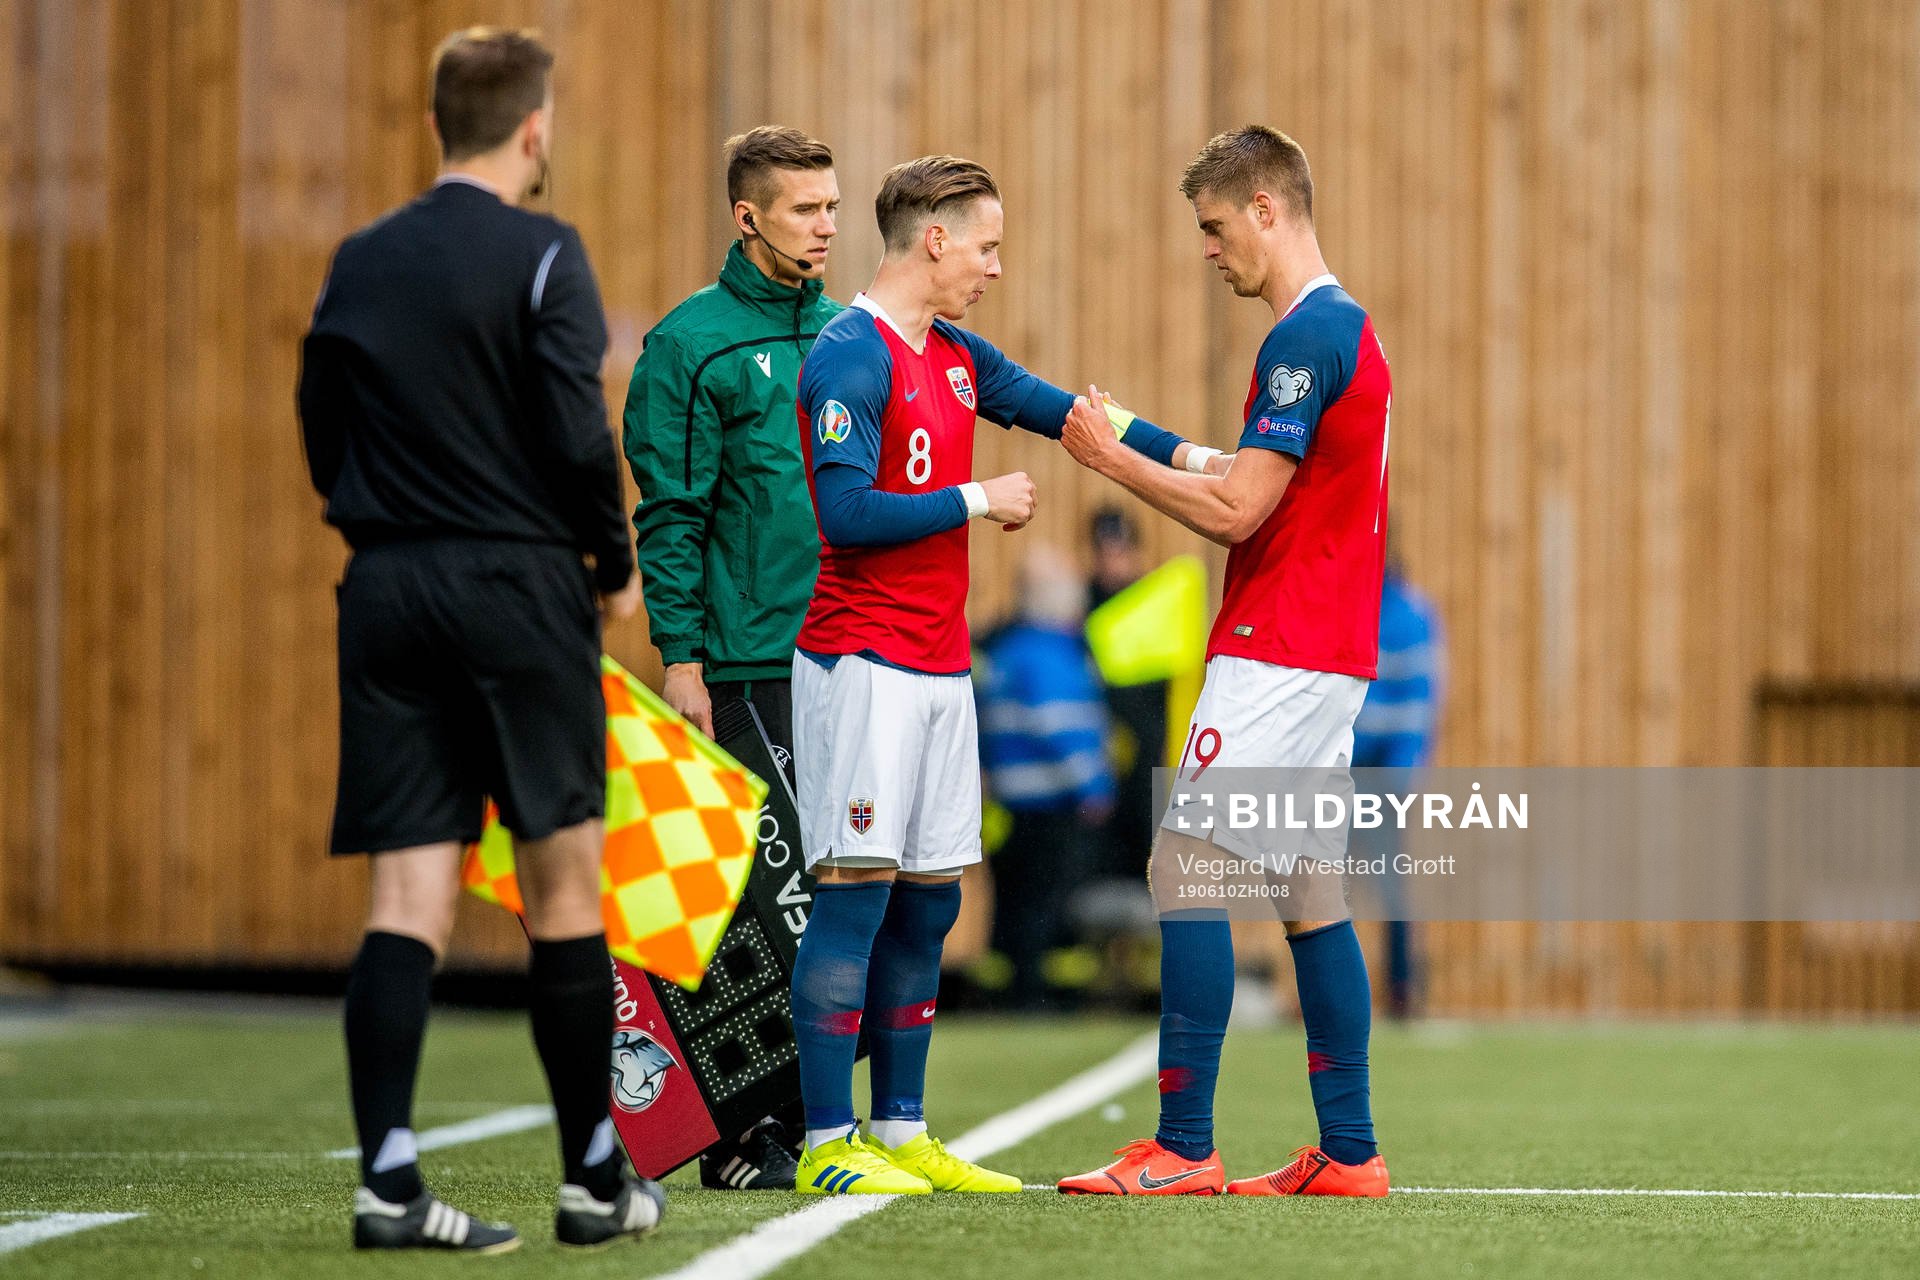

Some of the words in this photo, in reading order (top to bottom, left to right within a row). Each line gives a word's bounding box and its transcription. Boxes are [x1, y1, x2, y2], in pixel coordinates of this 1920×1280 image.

[906, 427, 932, 485] 8
[1270, 422, 1305, 437] RESPECT
[1178, 722, 1222, 783] 19
[755, 803, 791, 868] CO
[776, 869, 813, 948] FA
